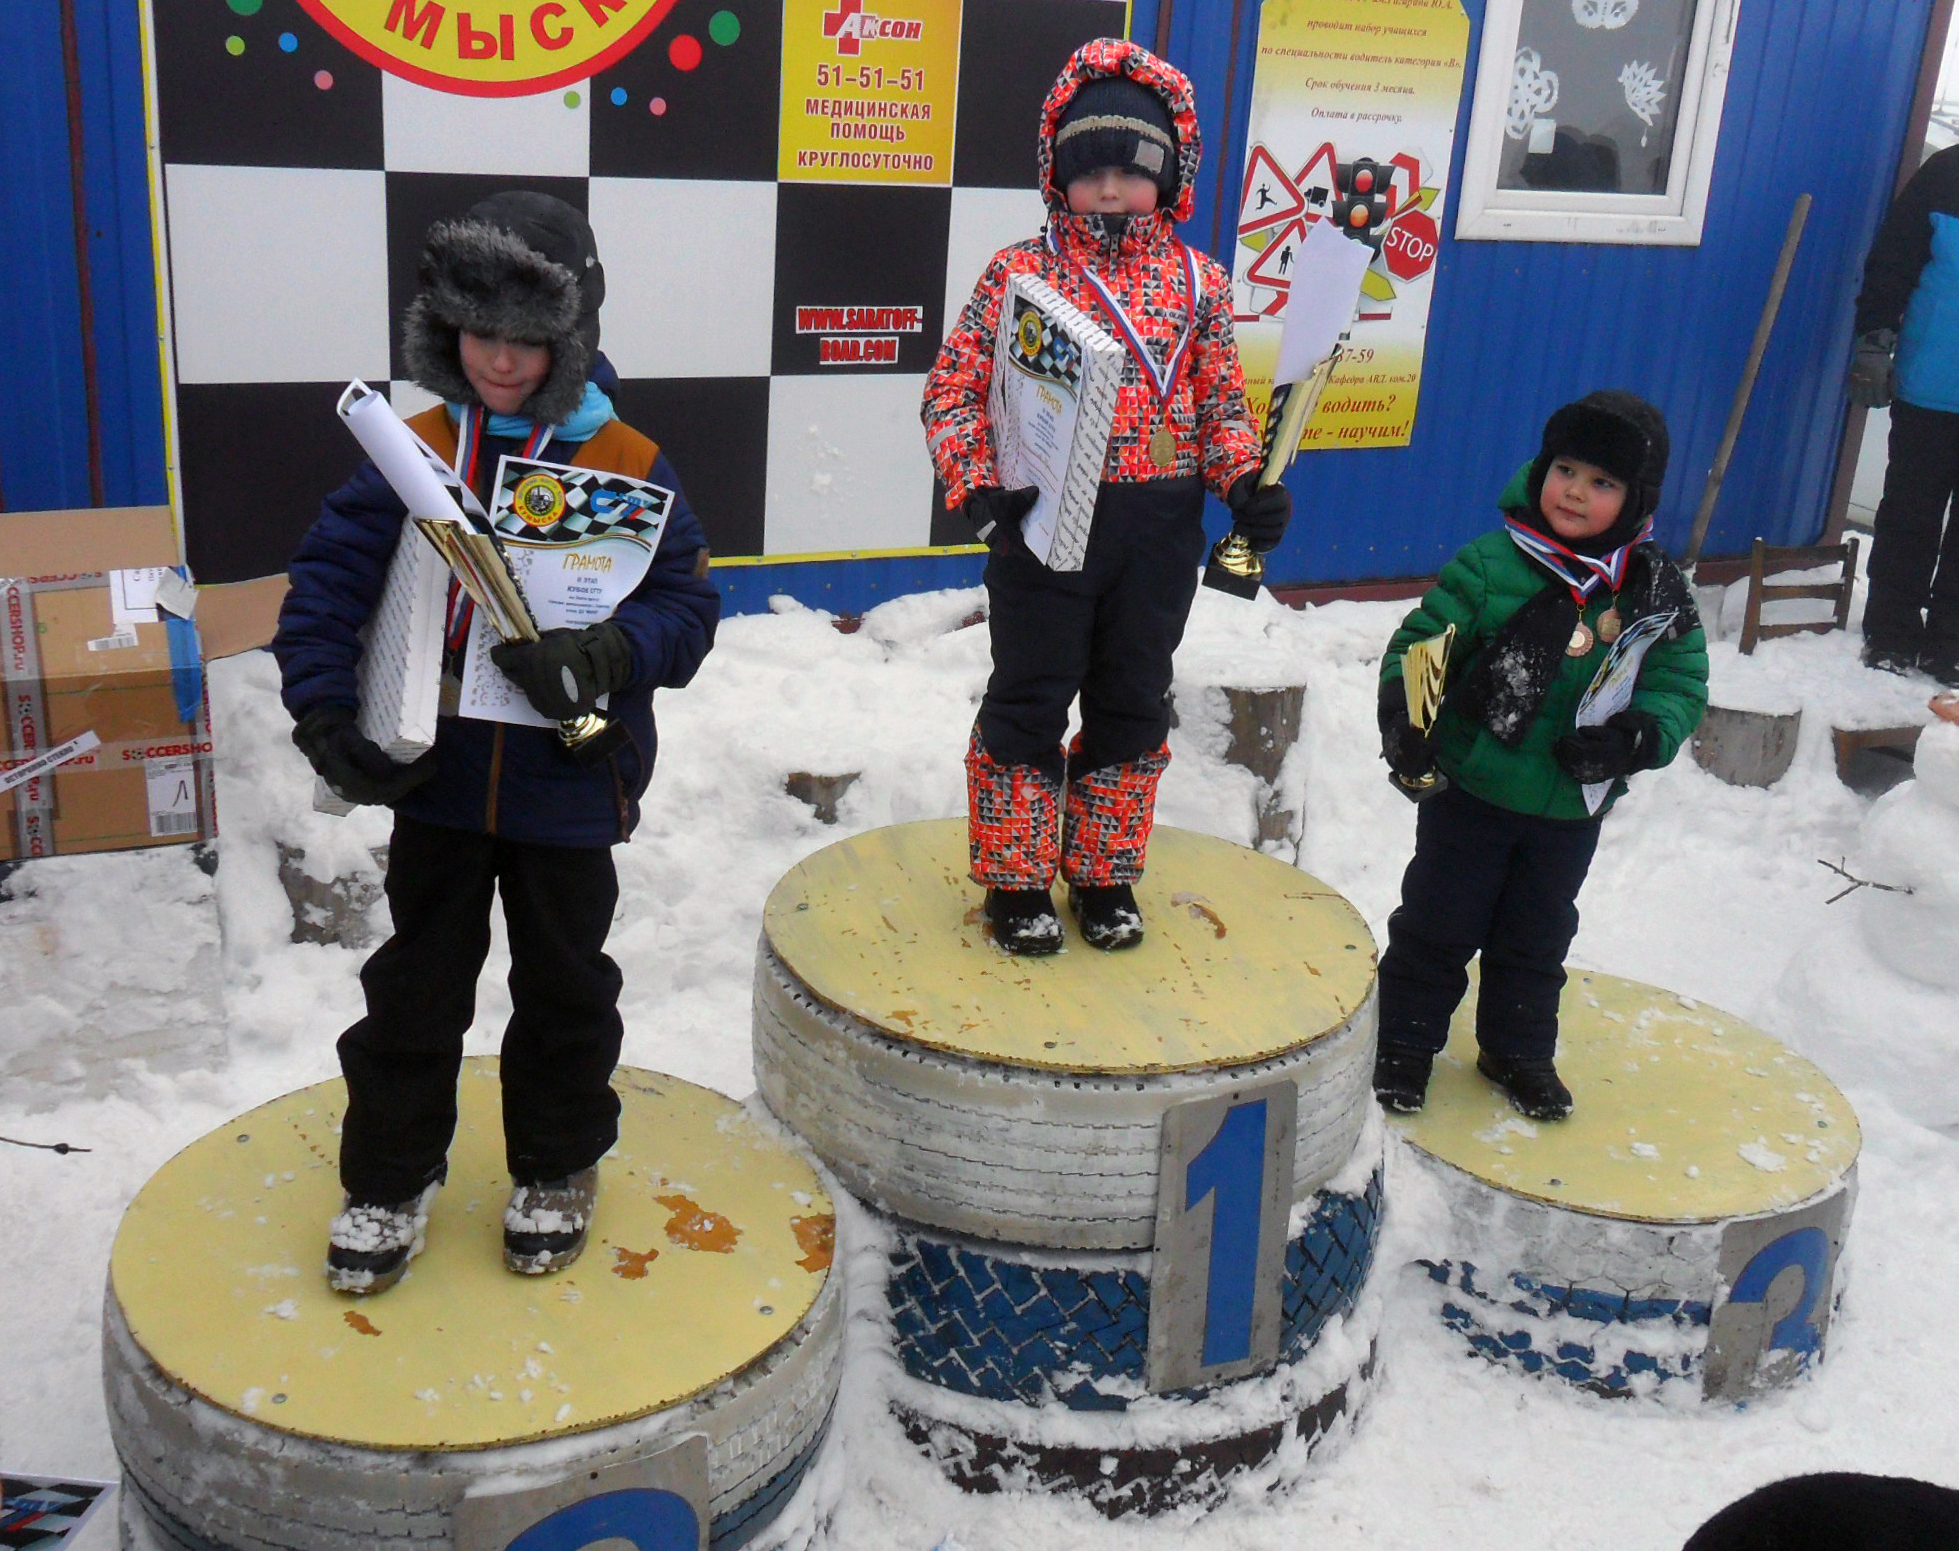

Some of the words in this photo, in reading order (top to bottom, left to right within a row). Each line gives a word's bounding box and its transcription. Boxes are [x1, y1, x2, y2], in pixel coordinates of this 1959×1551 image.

[1355, 21, 1382, 34] набор
[1261, 47, 1273, 55] по
[1275, 48, 1348, 61] специальности
[1350, 52, 1392, 64] водитель
[1305, 77, 1328, 90] Срок
[1330, 80, 1372, 92] обучения
[1374, 82, 1381, 92] 3
[805, 98, 931, 120] МЕДИЦИНСКАЯ
[1311, 107, 1348, 120] Оплата
[831, 122, 906, 143] ПОМОЩЬ
[798, 151, 933, 170] КРУГЛОСУТОЧНО
[1386, 227, 1434, 262] STOP
[820, 339, 896, 361] ROAD.COM
[1322, 394, 1396, 414] водить?
[1338, 420, 1409, 443] научим!
[563, 553, 613, 572] ГРАМОТА
[1186, 1098, 1267, 1366] 1
